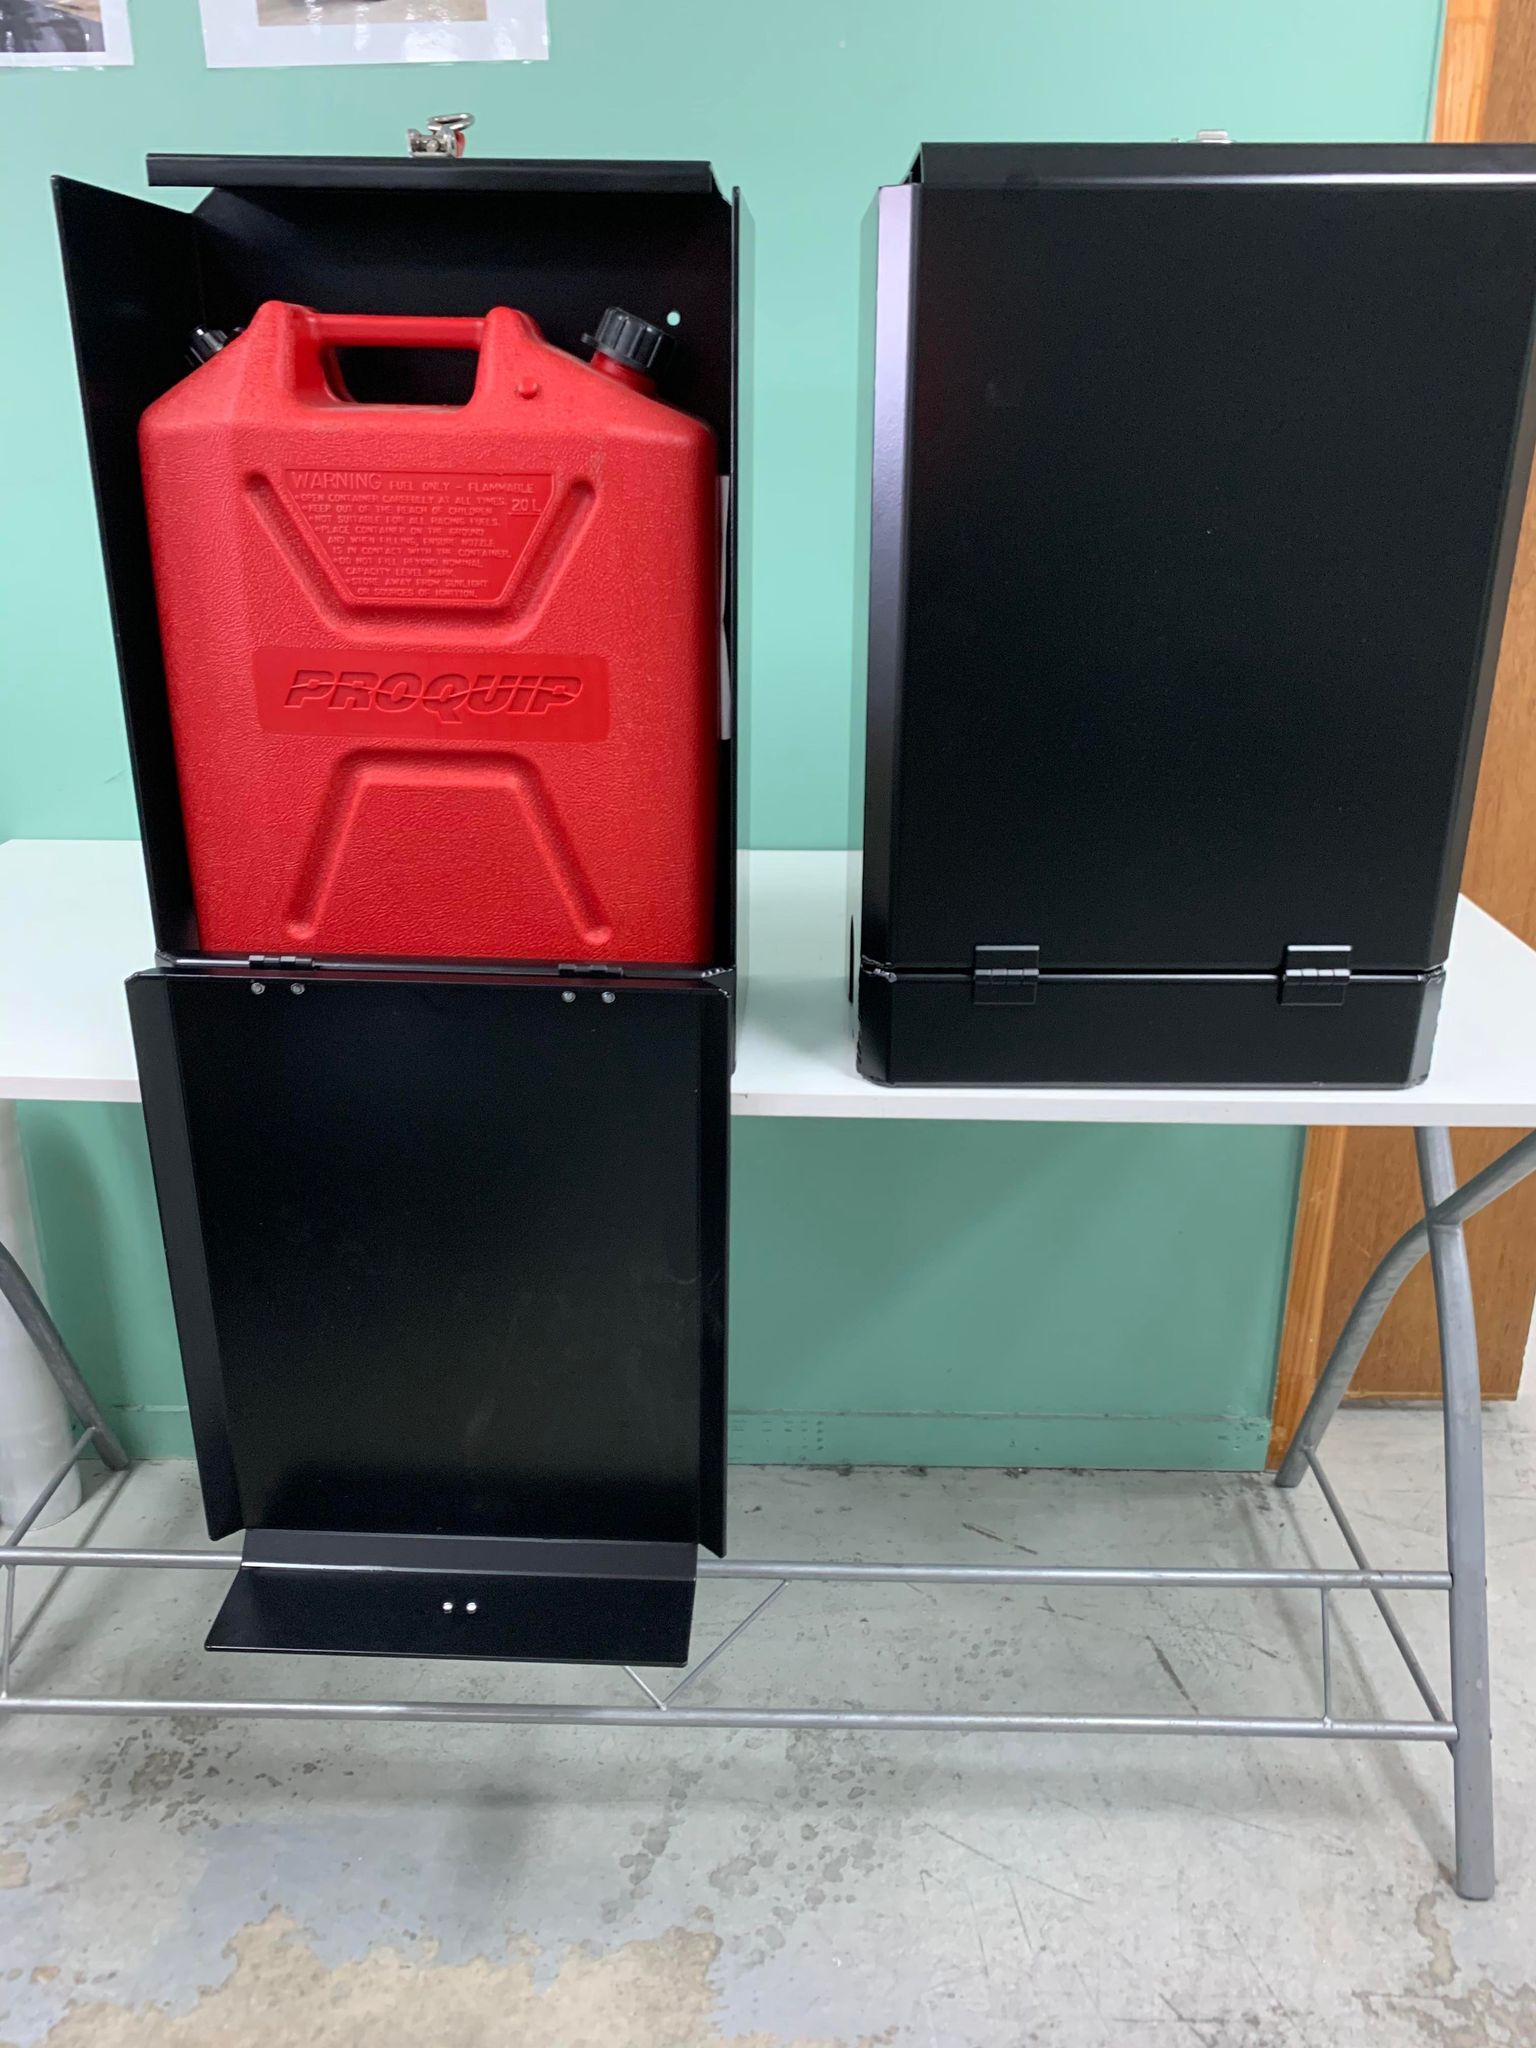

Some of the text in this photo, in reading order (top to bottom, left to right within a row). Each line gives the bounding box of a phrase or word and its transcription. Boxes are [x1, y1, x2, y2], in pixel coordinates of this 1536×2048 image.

[291, 471, 383, 490] WARNING
[389, 480, 416, 491] FUEL
[422, 481, 450, 492] ONLY
[468, 482, 535, 494] FLAMMABLE
[300, 493, 325, 502] OPEN
[328, 494, 379, 503] CONTAINER
[382, 495, 434, 504] CAREFULLY
[438, 496, 450, 504] AT
[455, 496, 471, 505] ALL
[308, 504, 331, 513] KEEP
[336, 504, 353, 513] OUT
[358, 505, 370, 513] OF
[375, 505, 392, 514] THE
[397, 505, 428, 514] REACH
[431, 506, 443, 515] OF
[511, 498, 542, 512] 20 L
[314, 515, 332, 524] NOT
[385, 516, 404, 525] FOR
[409, 517, 424, 525] ALL
[355, 526, 406, 535] CONTAINER
[410, 527, 424, 536] ON
[427, 527, 442, 536] THE
[327, 536, 345, 545] AND
[332, 546, 343, 555] IS
[347, 546, 358, 555] IN
[407, 547, 432, 556] WITH
[338, 556, 352, 565] DO
[355, 557, 372, 566] NOT
[345, 567, 390, 576] CAPACITY
[395, 568, 422, 577] LEVEL
[384, 578, 412, 587] AWAY
[417, 588, 431, 597] OF
[284, 669, 584, 724] PROQUIP
